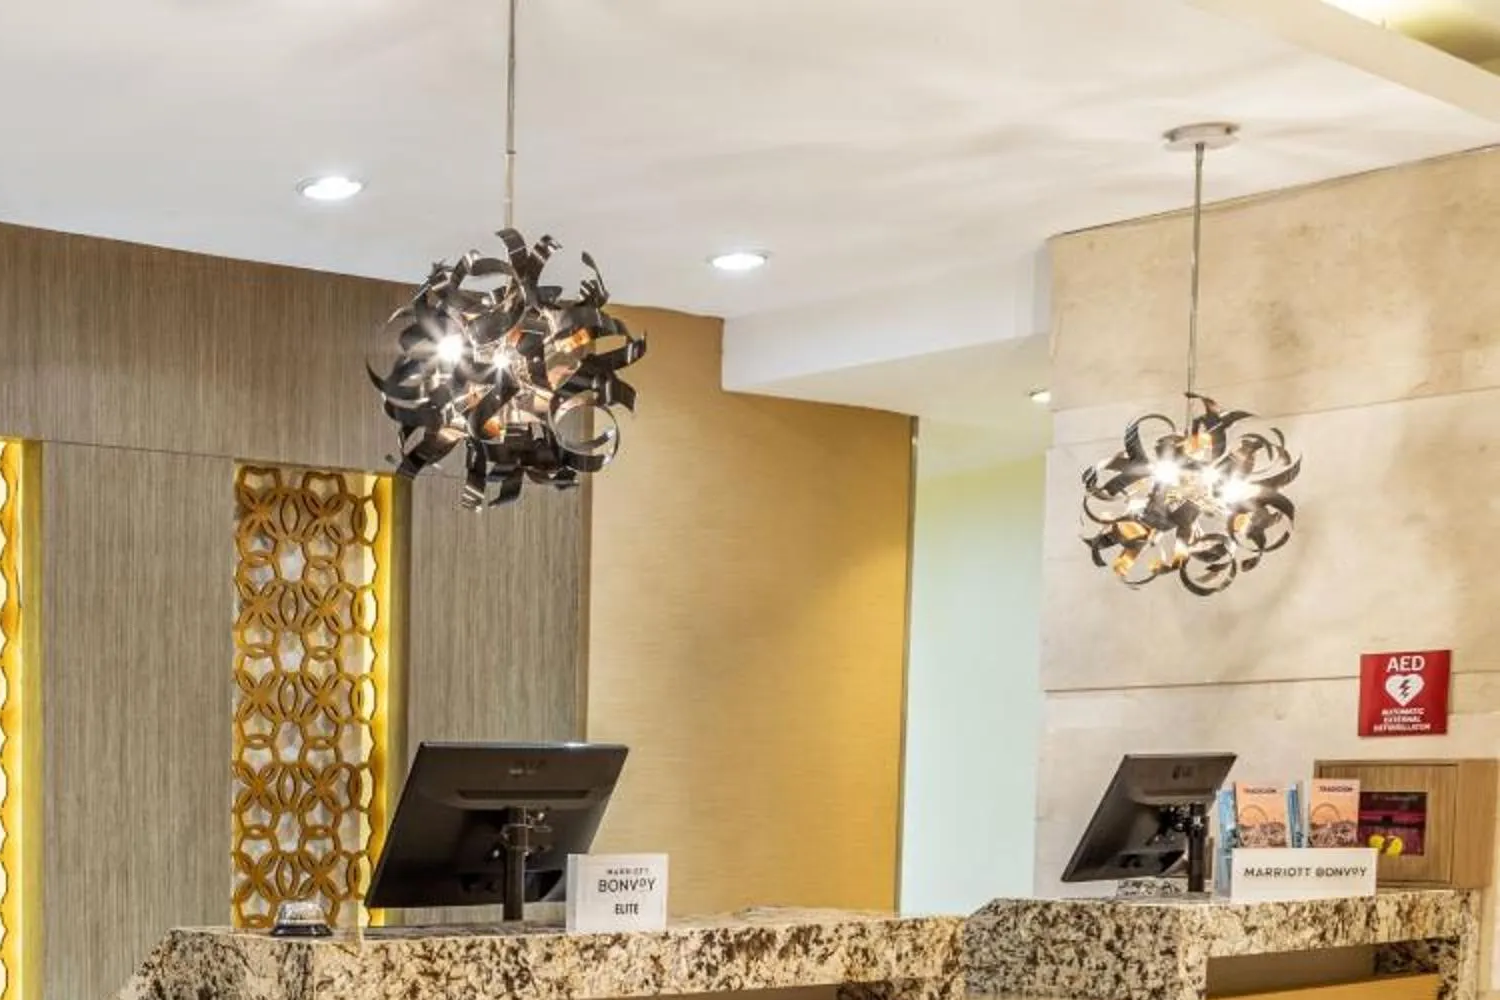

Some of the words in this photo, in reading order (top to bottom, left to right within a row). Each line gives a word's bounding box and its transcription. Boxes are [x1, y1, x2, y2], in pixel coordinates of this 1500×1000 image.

[1386, 655, 1425, 672] AED
[1243, 867, 1311, 877] MARRIOTT
[1315, 867, 1367, 877] BONVOY
[597, 878, 656, 893] BONVOY
[615, 903, 639, 915] ELITE
